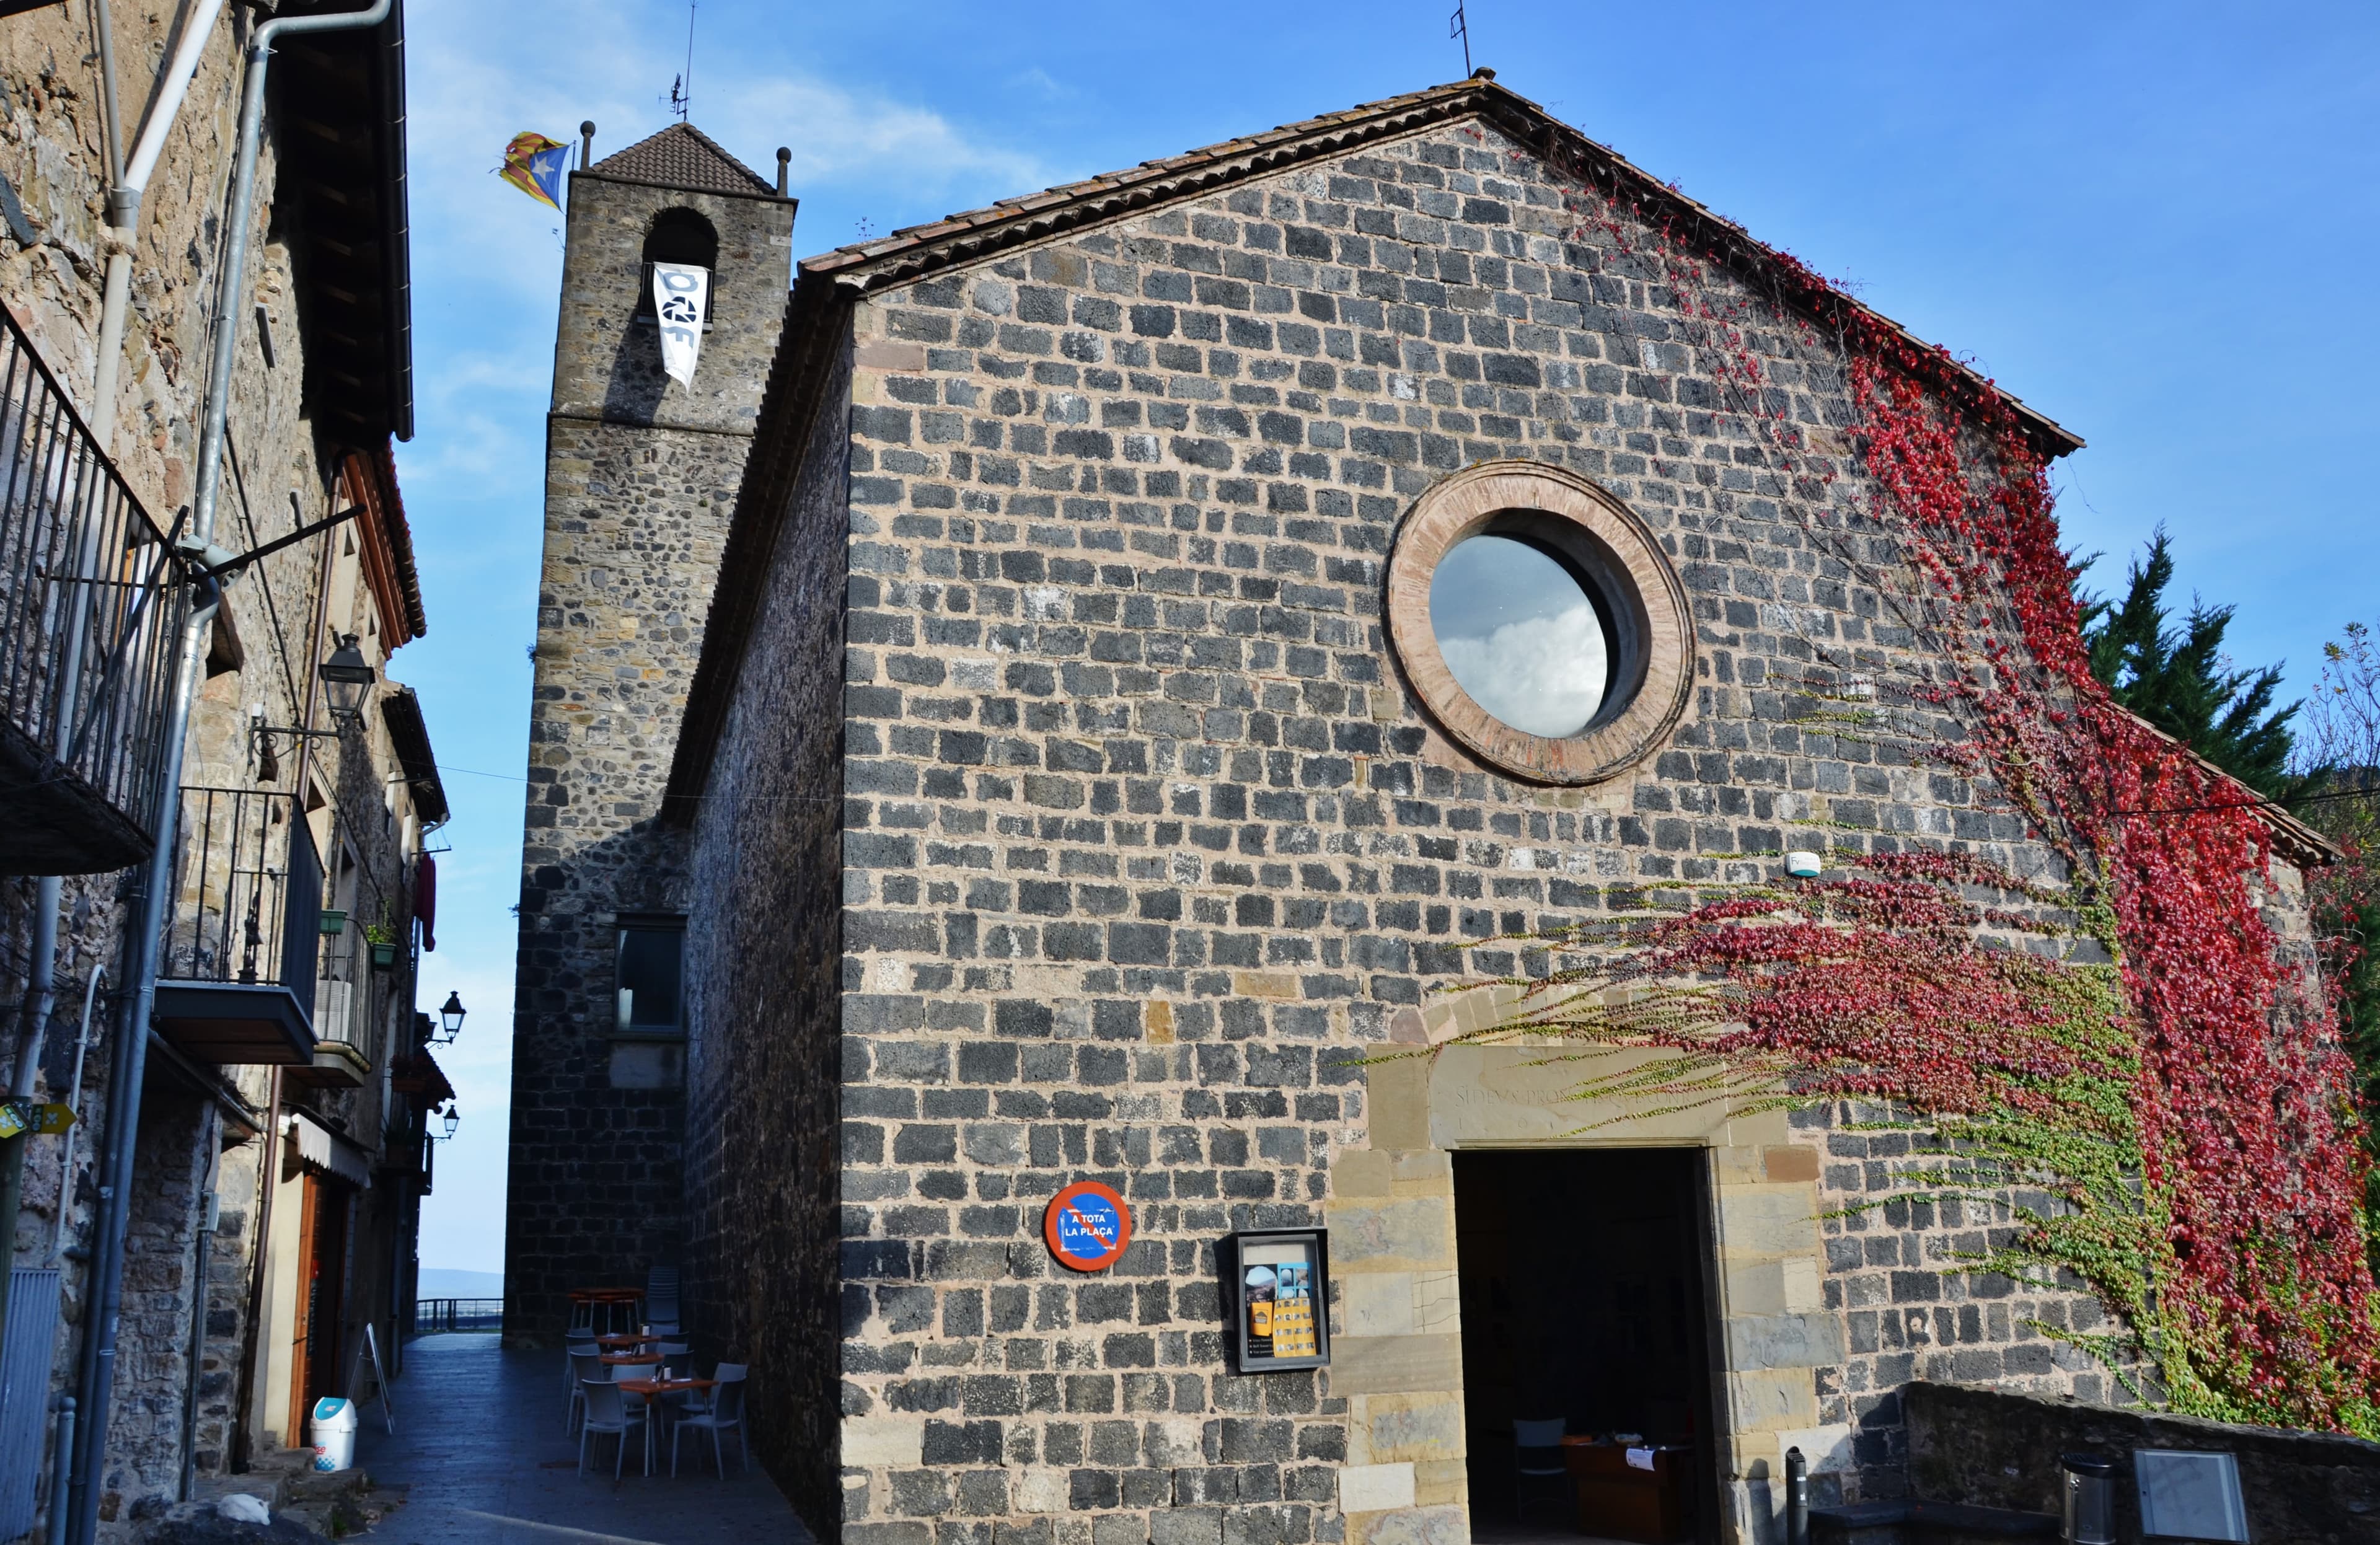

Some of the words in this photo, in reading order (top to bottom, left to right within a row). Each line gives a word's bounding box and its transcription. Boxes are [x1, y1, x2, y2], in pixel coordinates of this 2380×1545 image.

[1072, 1215, 1079, 1223] A
[1081, 1214, 1106, 1223] TOTA
[1065, 1228, 1078, 1236] LA
[1080, 1227, 1113, 1238] PLAÇA
